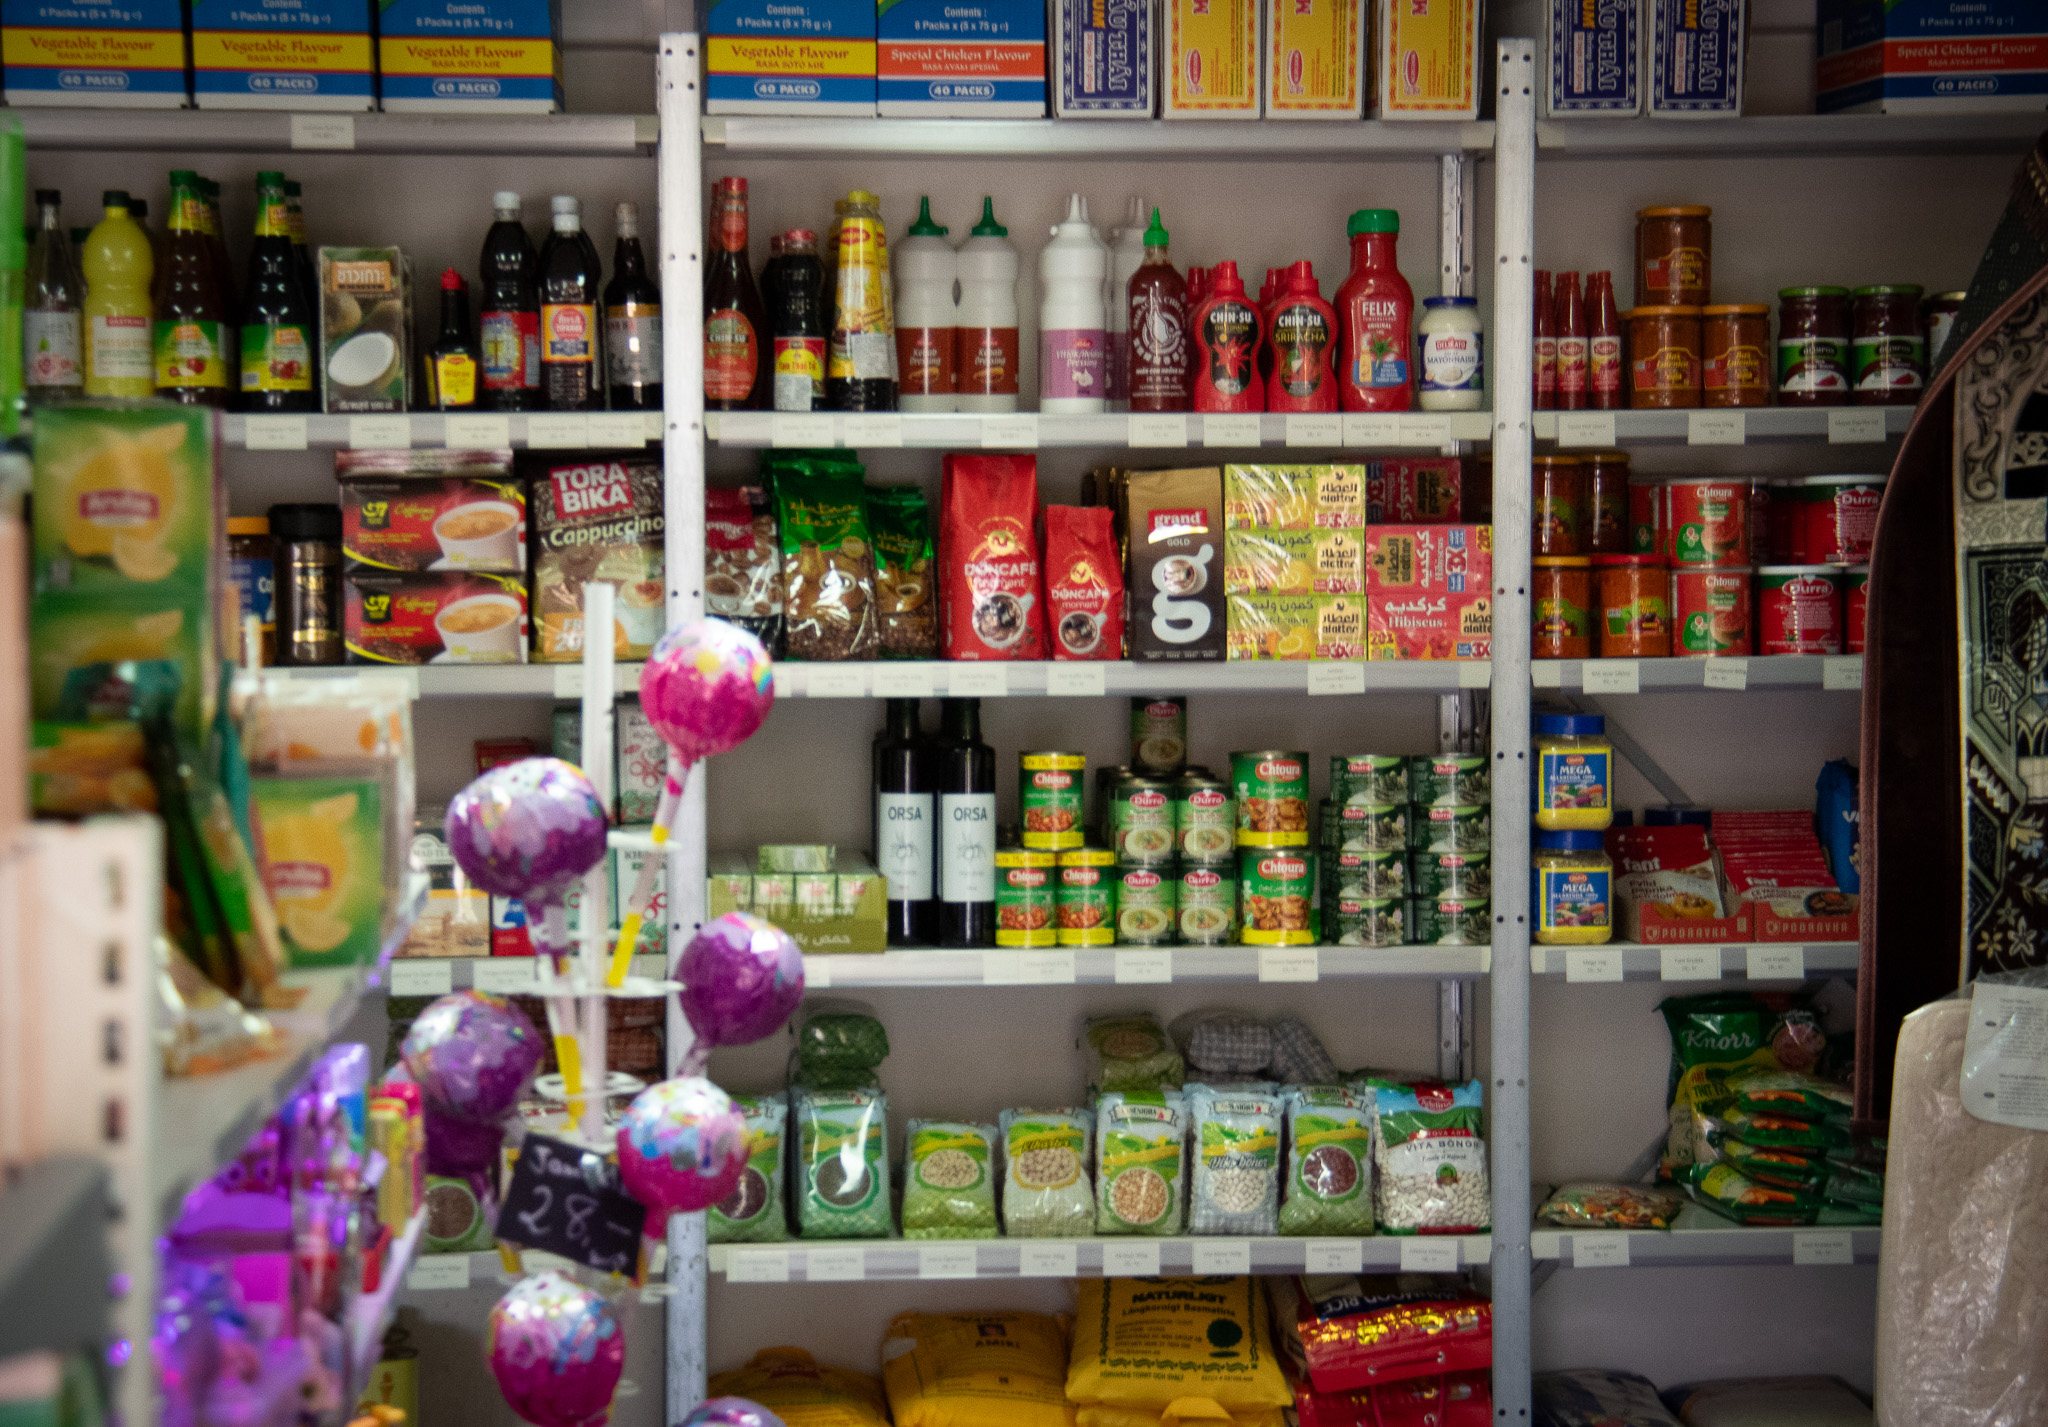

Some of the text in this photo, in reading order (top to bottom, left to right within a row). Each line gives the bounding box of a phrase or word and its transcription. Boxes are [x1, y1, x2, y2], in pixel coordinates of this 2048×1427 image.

[744, 19, 772, 29] Packs
[923, 21, 951, 32] Packs
[29, 35, 155, 54] Vegetable Flavour
[220, 40, 343, 56] Vegetable Flavour
[1897, 42, 2038, 59] Special Chicken Flavour
[406, 44, 525, 61] Vegetable Flavour
[730, 45, 850, 60] Vegetable Flavour
[891, 48, 1031, 62] Special Chicken Flavour
[64, 75, 125, 86] 40 PACKS
[253, 78, 313, 89] 40 PACKS
[1938, 79, 1995, 90] 40 PACKS
[439, 83, 496, 94] 40 PACKS
[760, 83, 816, 95] 40 PACKS
[934, 85, 992, 96] 40 PACKS
[1362, 301, 1397, 317] FELIX
[1275, 333, 1326, 343] SRIRACHA
[913, 348, 938, 357] Keab
[978, 348, 1003, 357] Keab
[909, 356, 941, 366] Dresing
[974, 356, 1006, 366] Dresing
[1427, 355, 1475, 364] MAYONNAISE
[553, 461, 629, 491] TORA
[1696, 486, 1734, 499] Chtoura
[561, 486, 629, 514] BIKA
[1841, 493, 1879, 506] Durra
[1154, 510, 1201, 528] grand
[548, 515, 664, 548] Cappuccino
[1167, 538, 1191, 547] GOLD
[1705, 575, 1742, 587] Chtoura
[1791, 583, 1828, 594] Durra
[1061, 600, 1099, 609] moment
[1388, 616, 1443, 629] Hibiscus
[1259, 763, 1301, 775] Chtoura
[1559, 765, 1591, 775] MEGA
[888, 806, 922, 821] ORSA
[953, 806, 988, 821] ORSA
[1261, 861, 1305, 874] Chtoura
[1561, 884, 1594, 894] MEGA
[1662, 926, 1728, 939] PODRAVKA
[1782, 921, 1848, 934] PODRAVKA
[1682, 1029, 1756, 1050] Knorr
[1406, 1140, 1431, 1153] VITA
